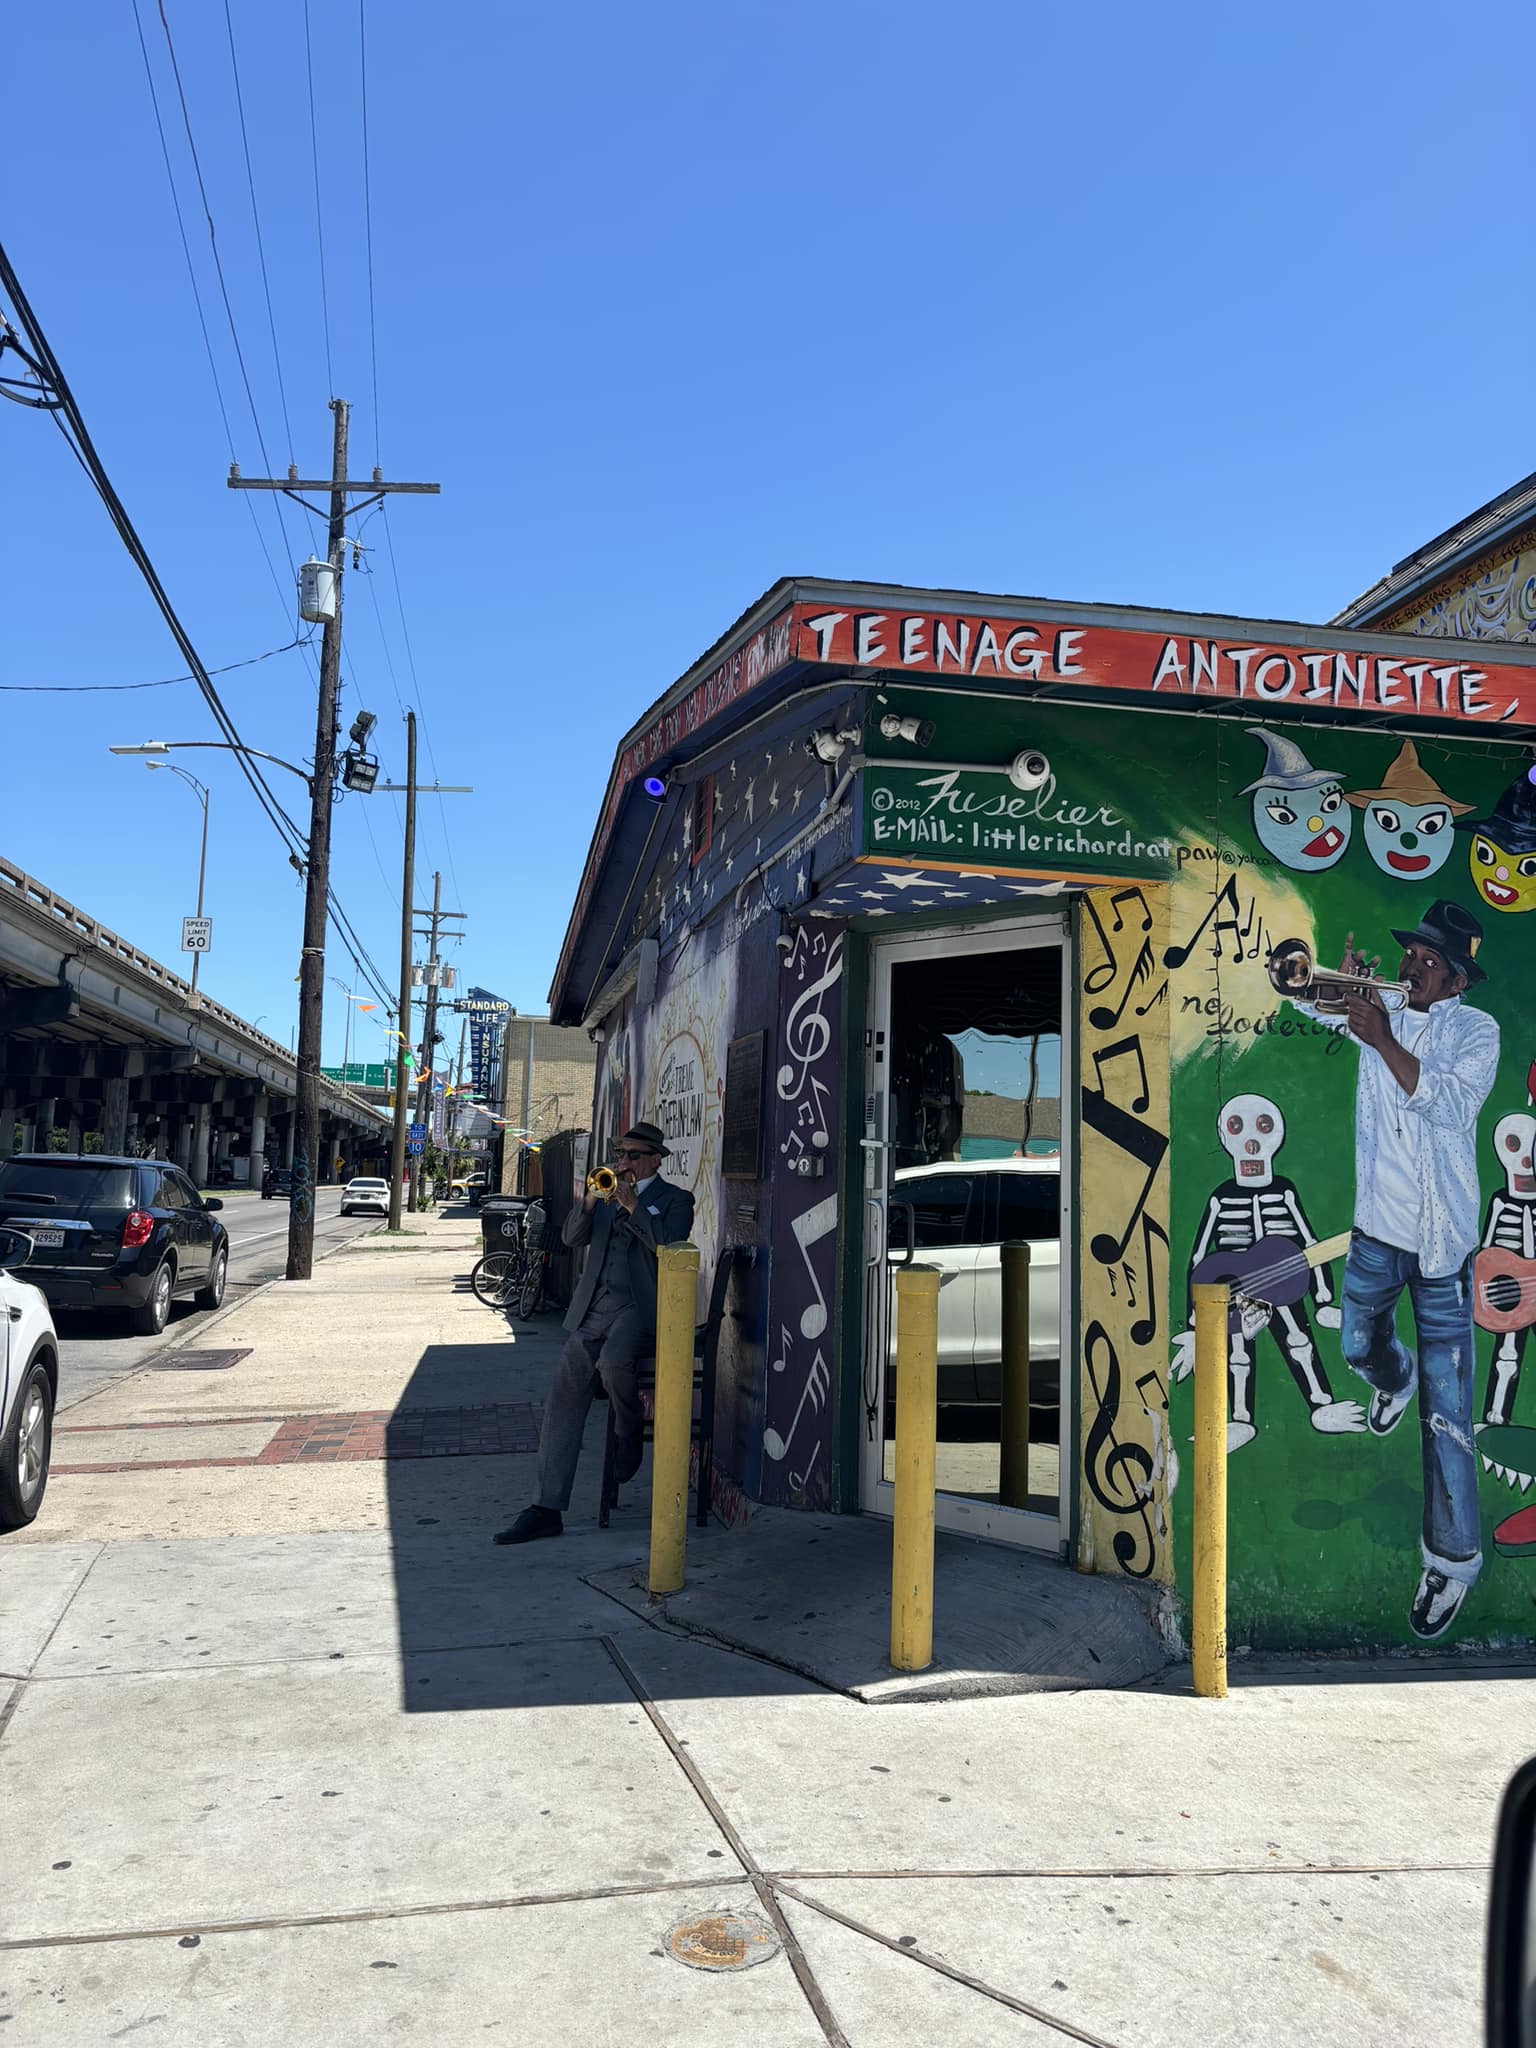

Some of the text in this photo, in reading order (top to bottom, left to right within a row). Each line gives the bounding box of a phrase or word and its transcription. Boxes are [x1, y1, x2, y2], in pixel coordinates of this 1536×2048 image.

[1458, 568, 1473, 585] OF
[1476, 554, 1496, 573] MY
[1502, 530, 1536, 561] HEAR
[803, 612, 1088, 679] TEENAGE
[1151, 637, 1519, 721] ANTOINETTE,
[915, 770, 1124, 827] Fuselier
[186, 920, 210, 928] SPEED
[187, 937, 206, 948] 60
[459, 1000, 509, 1011] STANDARD
[476, 1013, 499, 1023] LIFE
[1206, 1008, 1351, 1056] loitering
[411, 1143, 422, 1152] 10
[666, 1149, 690, 1176] LOUNGE
